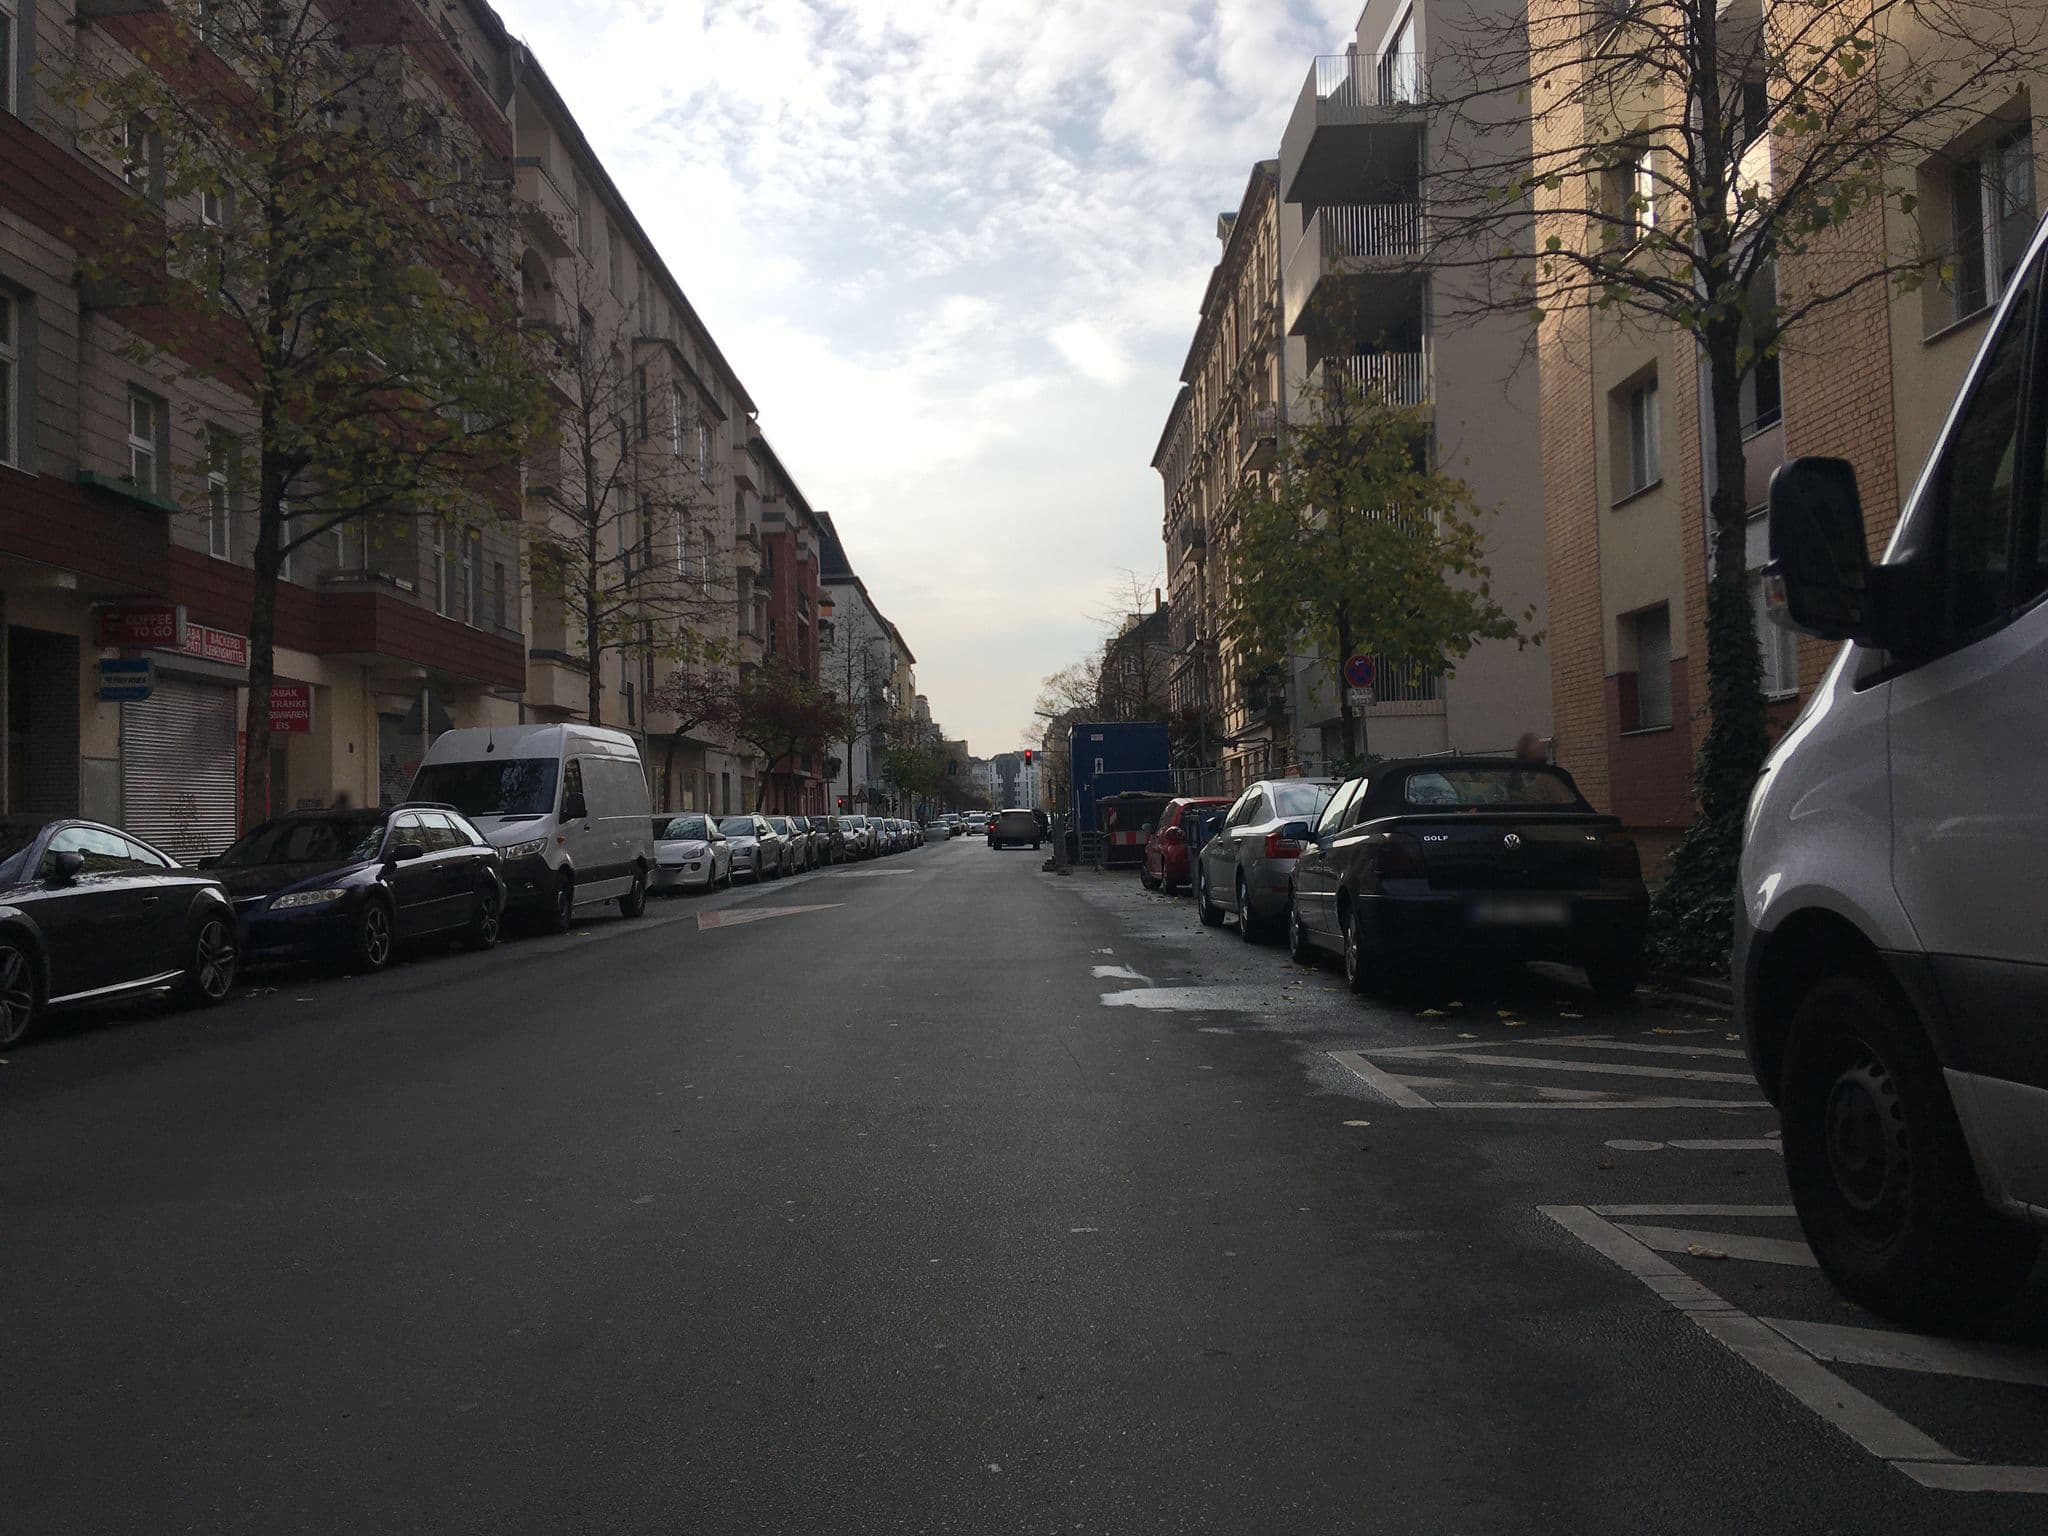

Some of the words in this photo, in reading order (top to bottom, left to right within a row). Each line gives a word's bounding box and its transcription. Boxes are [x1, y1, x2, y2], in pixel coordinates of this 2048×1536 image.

[125, 613, 173, 625] COFFEE
[134, 625, 149, 637] TO
[152, 625, 173, 637] GO
[206, 644, 245, 663] LEBENSMITTEL
[268, 710, 309, 719] SSWAREN
[275, 721, 291, 730] EIS
